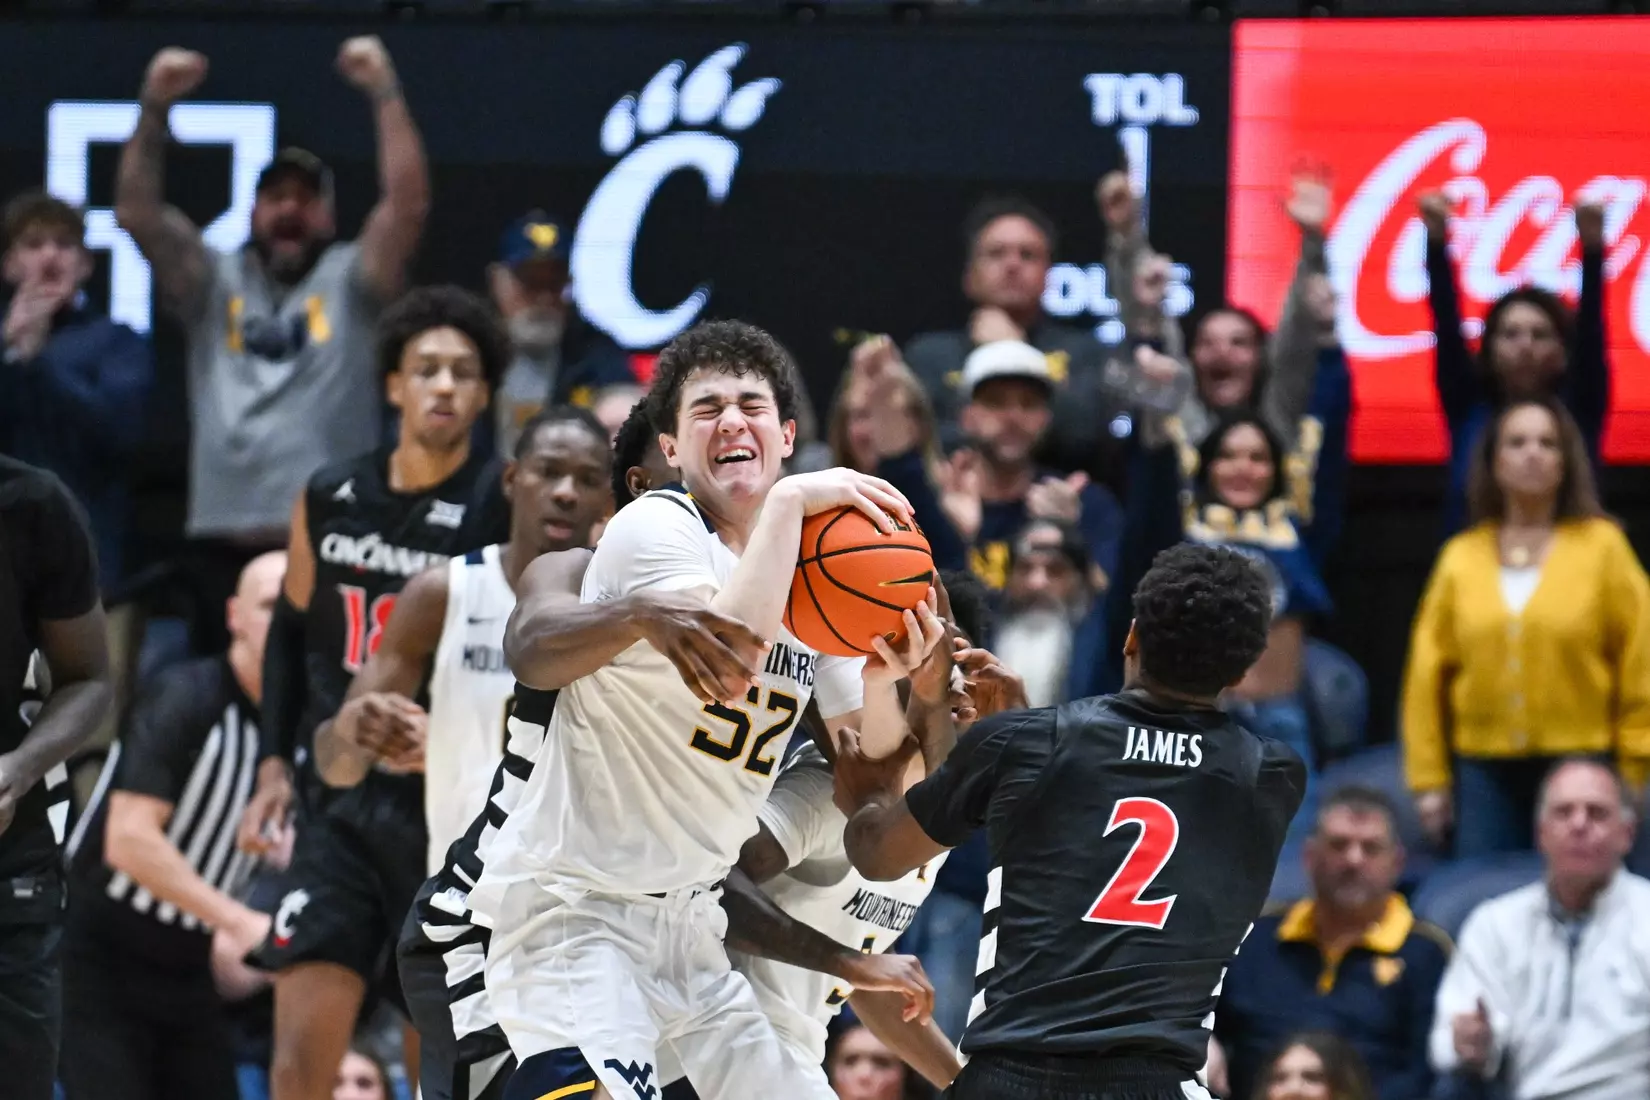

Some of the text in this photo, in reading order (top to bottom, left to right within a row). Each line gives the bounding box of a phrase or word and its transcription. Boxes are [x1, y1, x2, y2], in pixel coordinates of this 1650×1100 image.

[1083, 72, 1200, 126] TOL
[688, 684, 799, 778] 52
[1121, 726, 1203, 769] JAMES
[1080, 796, 1180, 930] 2
